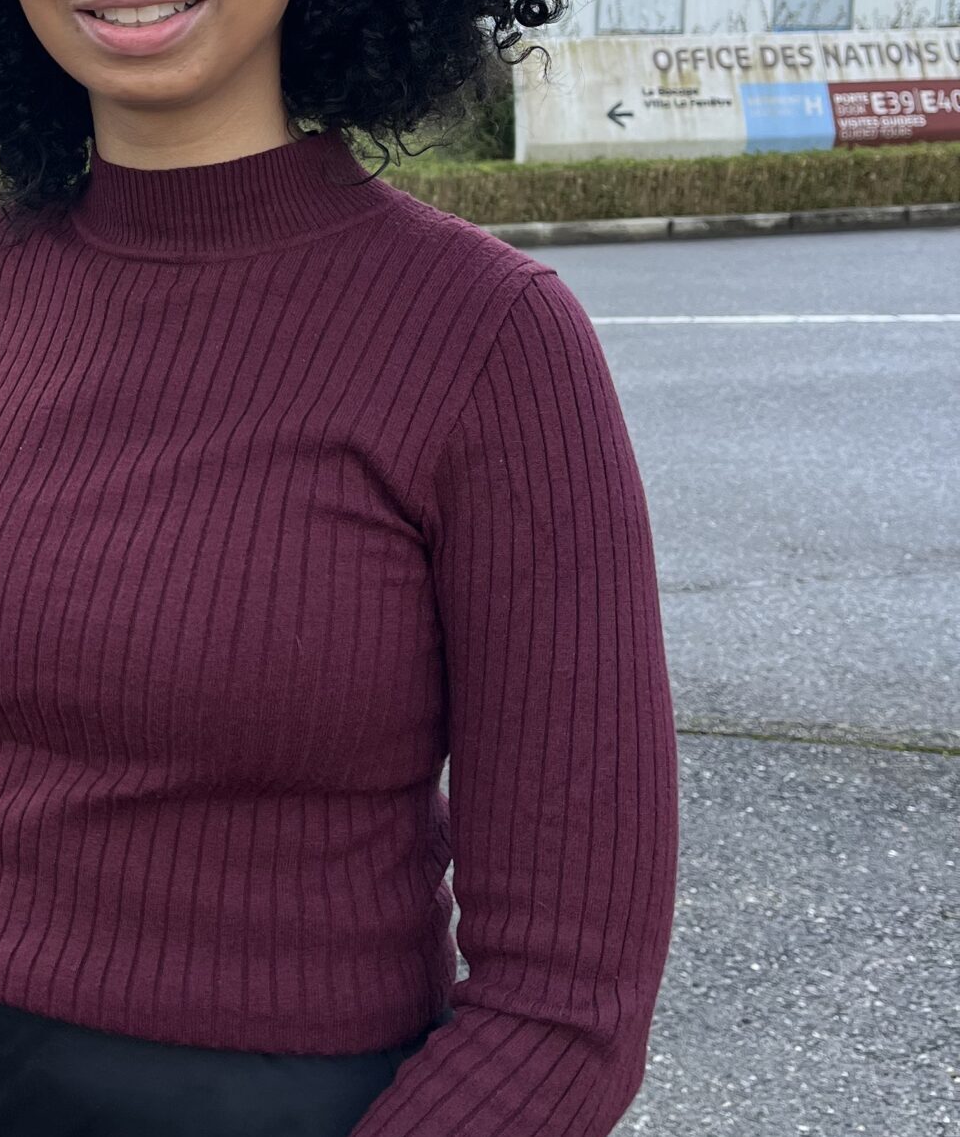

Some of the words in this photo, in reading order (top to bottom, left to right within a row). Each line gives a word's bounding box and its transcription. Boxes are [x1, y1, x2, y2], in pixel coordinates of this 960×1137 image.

[652, 46, 753, 72] OFFICE
[759, 43, 813, 68] DES
[822, 40, 939, 68] NATIONS
[804, 94, 824, 117] H
[870, 90, 916, 115] E39
